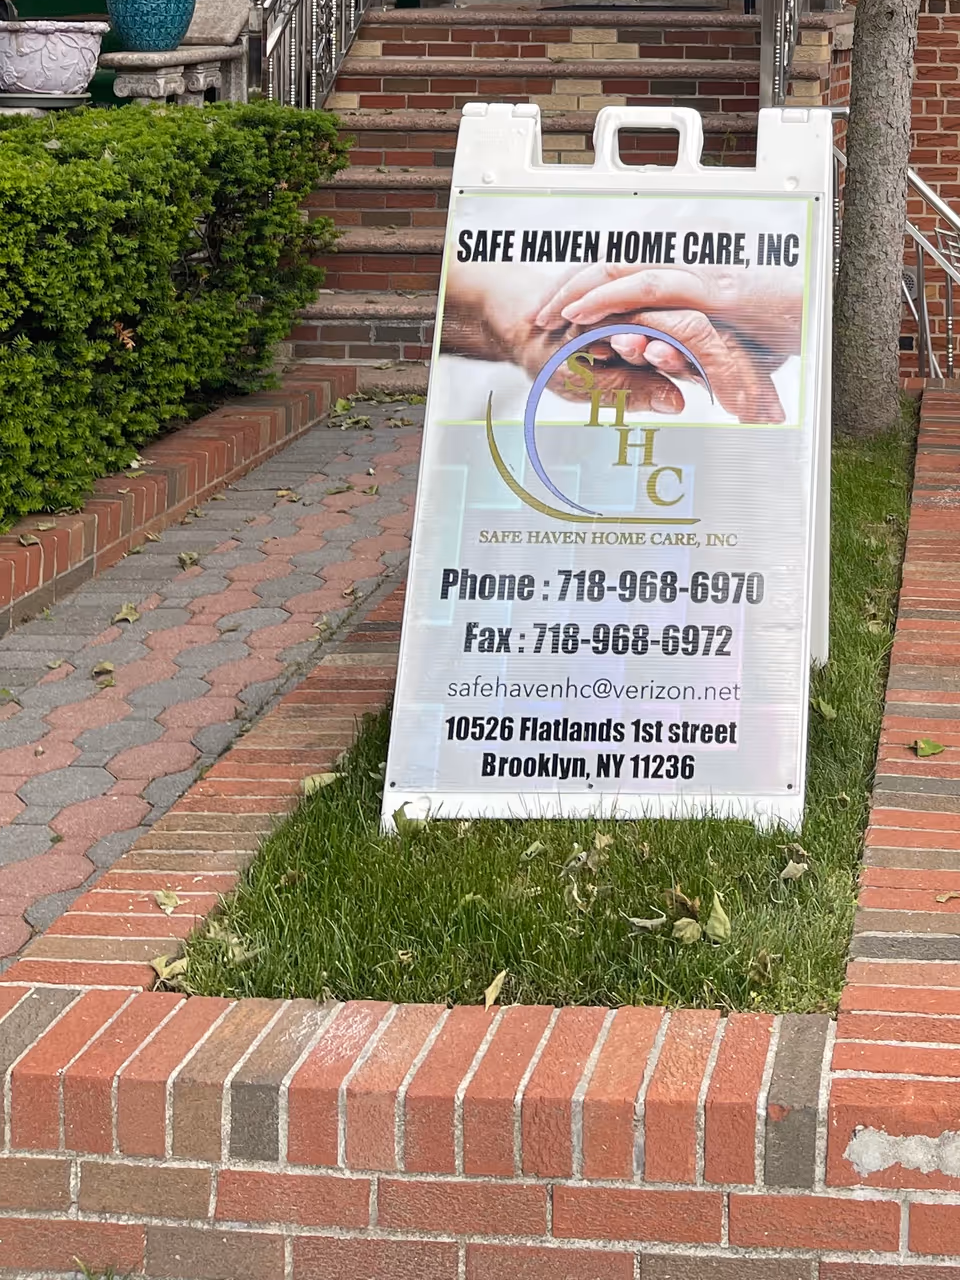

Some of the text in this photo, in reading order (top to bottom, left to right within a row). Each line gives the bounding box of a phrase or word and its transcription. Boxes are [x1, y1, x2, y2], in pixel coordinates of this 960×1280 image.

[456, 229, 800, 269] SAFE HAVEN HOME CARE, INC
[478, 529, 739, 549] SAFE HAVEN HOME CARE, INC
[439, 568, 536, 602] Phone
[556, 569, 765, 605] 718-968-6970
[462, 622, 512, 654] Fax
[532, 623, 733, 657] 718-968-6972
[446, 676, 742, 703] safehavenhc@verizon.net
[444, 716, 738, 745] 10526 Flatlands 1st street
[481, 751, 696, 781] Brooklyn, NY 11236
